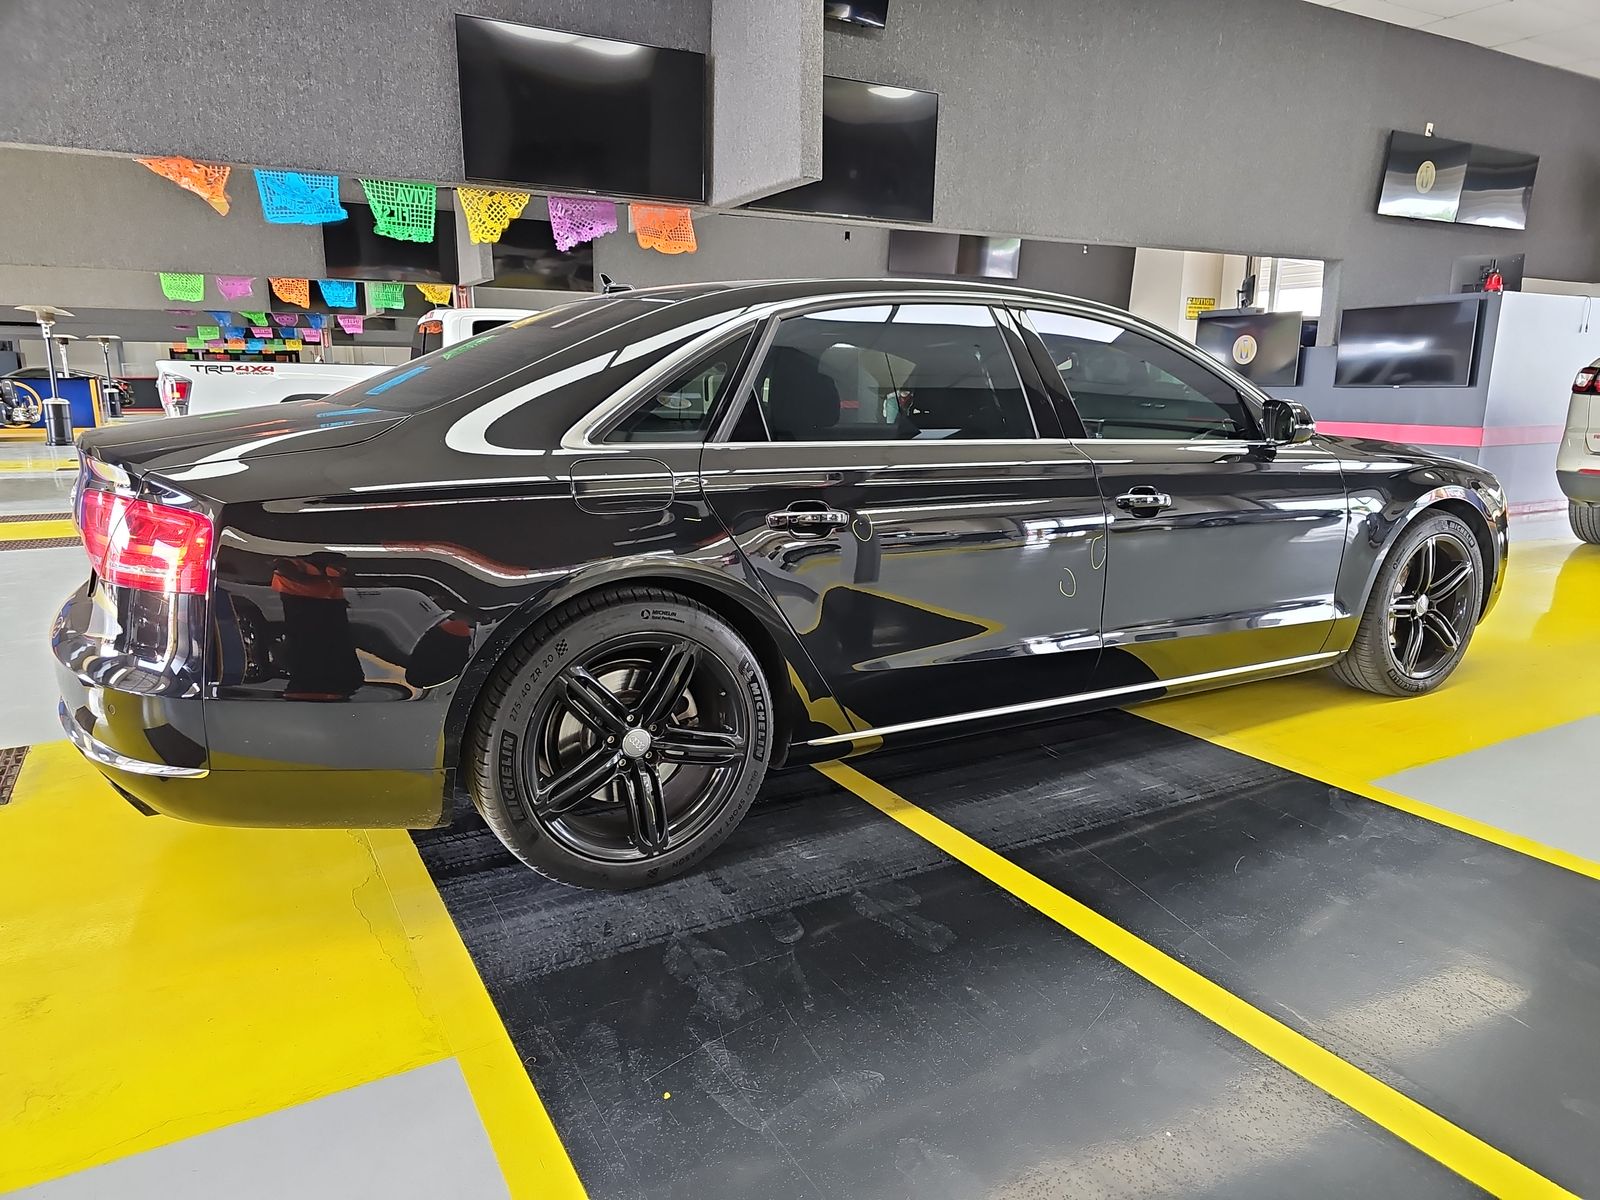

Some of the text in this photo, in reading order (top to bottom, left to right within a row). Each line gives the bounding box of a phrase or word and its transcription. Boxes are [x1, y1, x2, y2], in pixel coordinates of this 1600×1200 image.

[1187, 297, 1214, 305] CAUTION
[190, 365, 235, 375] TRD
[530, 667, 543, 683] ZR
[542, 654, 554, 669] 20
[750, 682, 766, 759] MICHELIN
[501, 735, 525, 820] MICHELIN
[725, 798, 746, 827] SPORT
